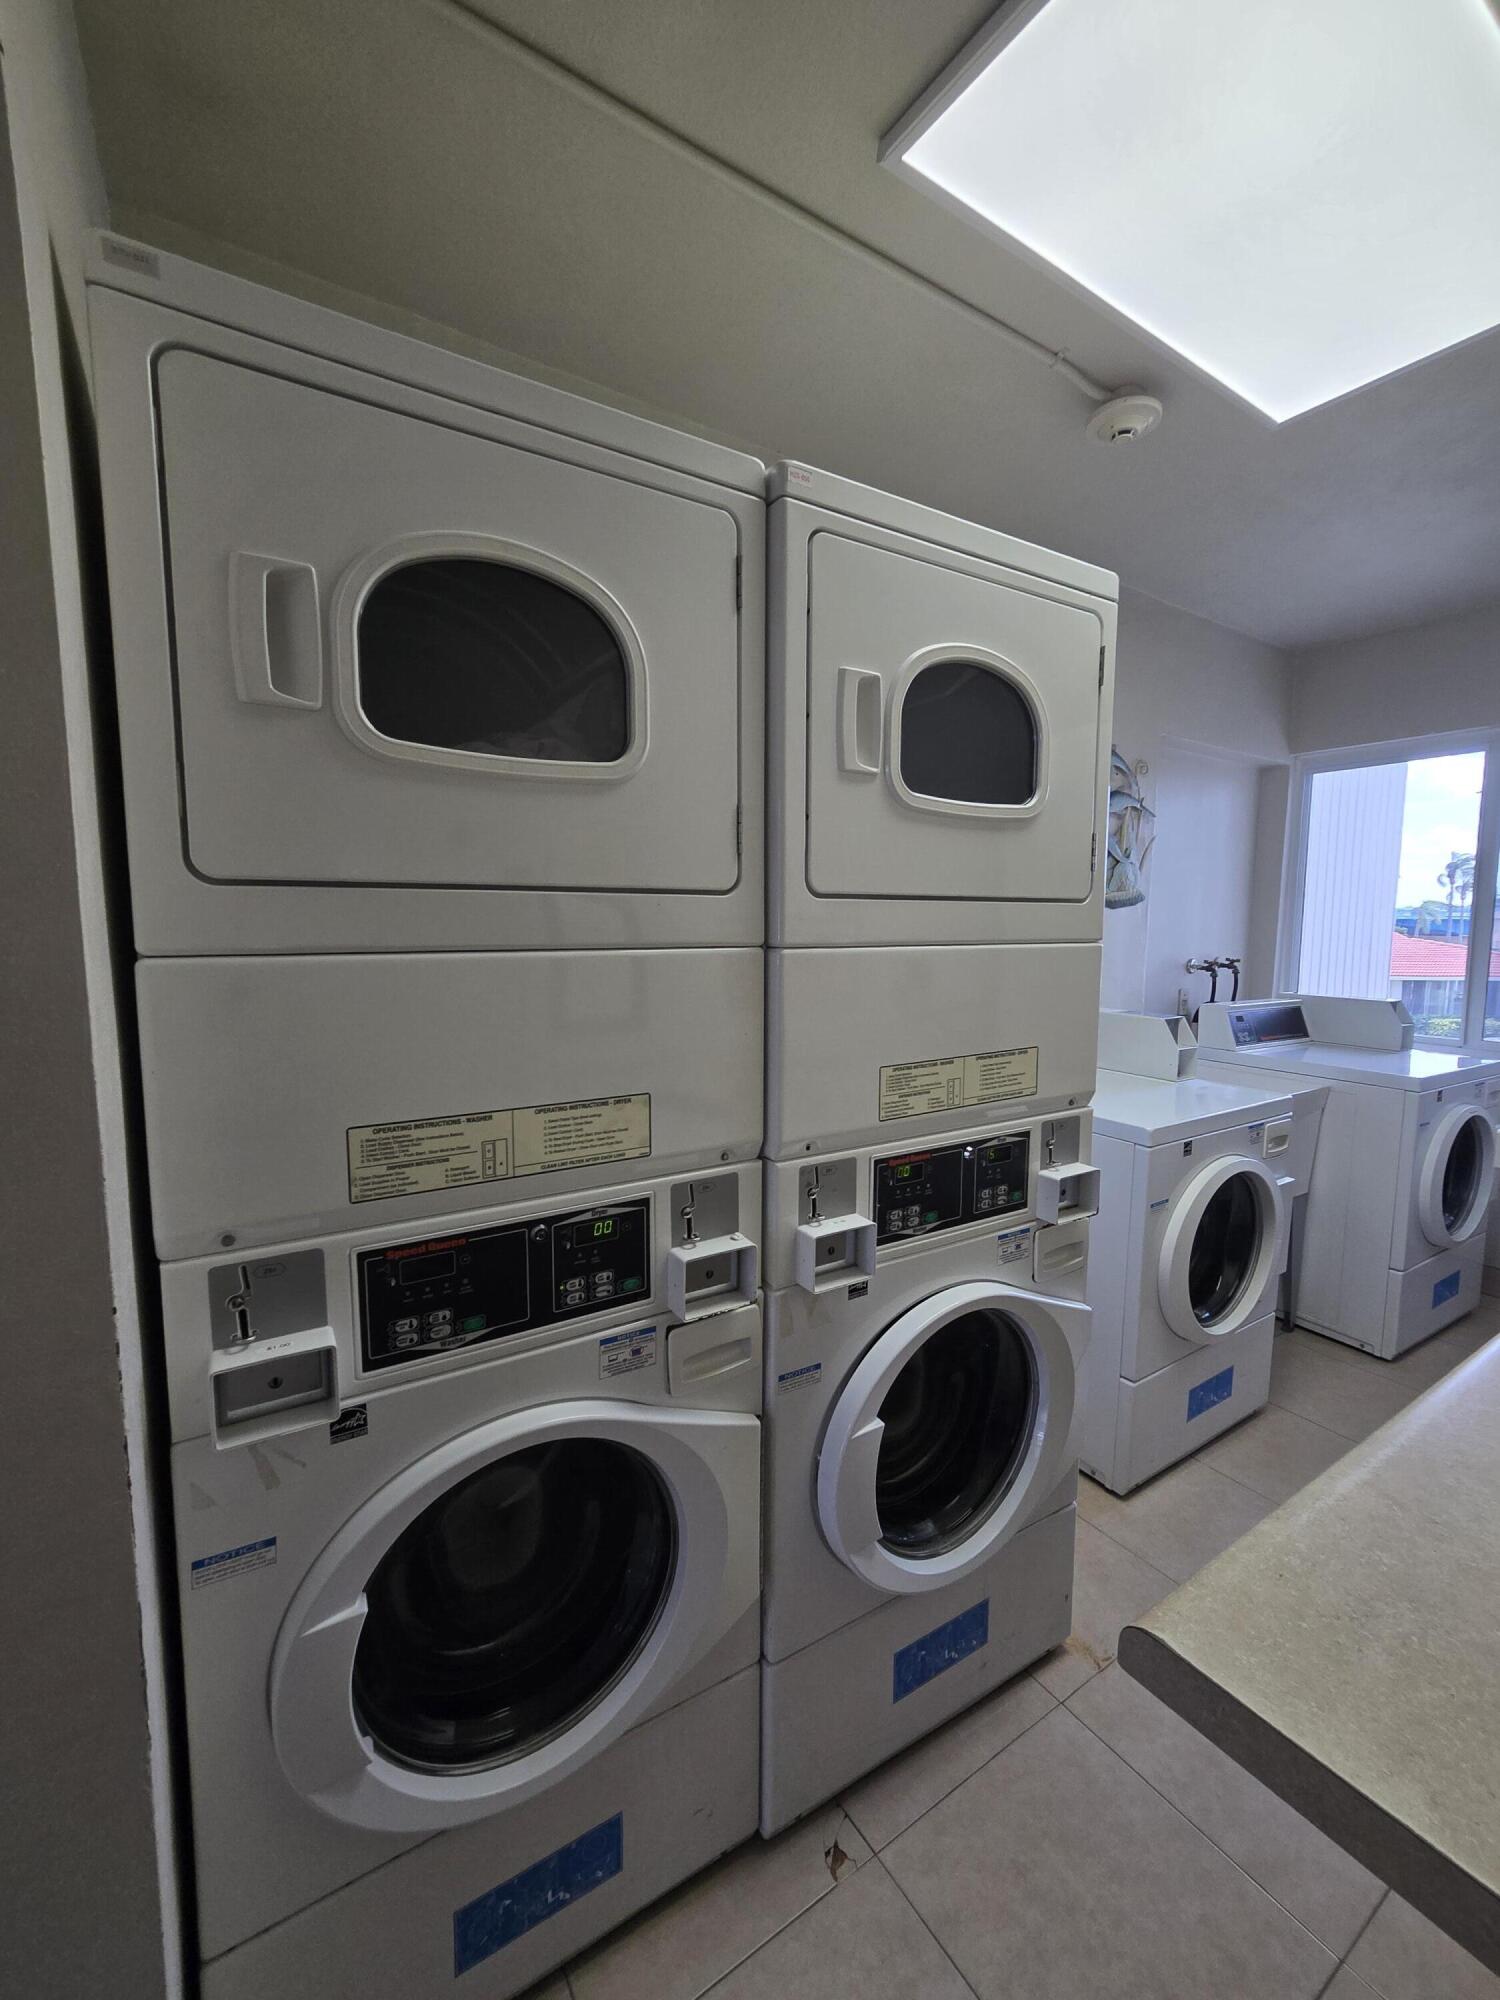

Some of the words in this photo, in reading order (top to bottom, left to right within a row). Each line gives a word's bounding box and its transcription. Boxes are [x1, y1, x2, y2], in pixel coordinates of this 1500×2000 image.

[534, 1105, 568, 1115] OPERATING
[372, 1124, 412, 1135] OPERATING
[413, 1118, 462, 1130] INSTRUCTIONS
[466, 1115, 493, 1124] WASHER
[593, 1220, 613, 1236] 00
[385, 1245, 426, 1260] Speed
[427, 1238, 467, 1251] Queen
[203, 1541, 268, 1566] NOTICE
